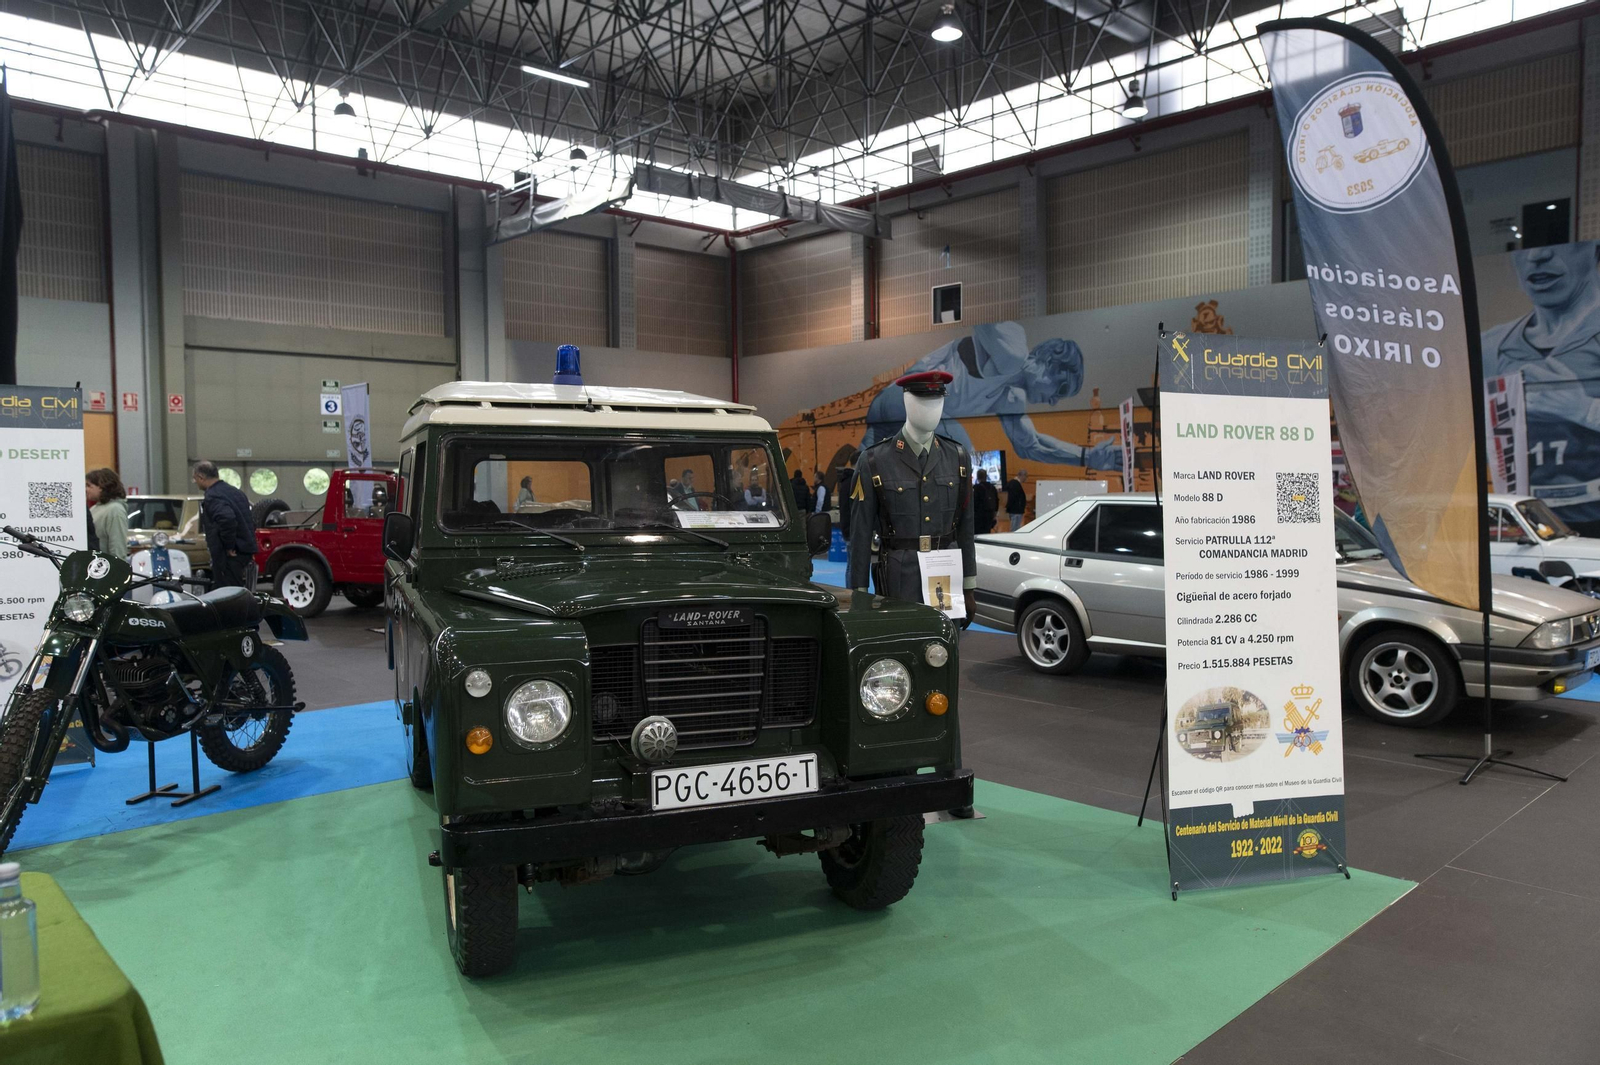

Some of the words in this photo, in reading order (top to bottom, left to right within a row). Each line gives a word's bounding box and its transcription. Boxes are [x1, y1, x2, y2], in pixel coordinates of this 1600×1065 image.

[1204, 349, 1278, 368] Guardia
[1287, 353, 1322, 370] Civil
[0, 396, 31, 407] dia
[41, 396, 77, 409] Civil
[328, 401, 336, 411] 3
[1176, 423, 1219, 439] LAND
[1223, 424, 1275, 440] ROVER
[1280, 426, 1299, 441] 88
[1304, 427, 1315, 441] D
[8, 448, 70, 460] DESERT
[1530, 440, 1568, 466] 17
[1173, 471, 1196, 479] Marca
[1197, 470, 1222, 480] LAND
[1225, 471, 1255, 480] ROVER
[1202, 492, 1214, 501] 88
[1216, 493, 1223, 501] D
[1175, 516, 1189, 524] Año
[1190, 516, 1230, 524] fabricación
[1231, 515, 1256, 524] 1986
[1175, 537, 1203, 545] Servicio
[1205, 536, 1252, 545] PATRULLA
[1254, 535, 1276, 544] 112ª
[0, 551, 24, 559] 980
[1199, 549, 1268, 558] COMANDANCIA
[1270, 548, 1308, 558] MADRID
[1176, 571, 1203, 580] Período
[1204, 571, 1214, 579] de
[1215, 571, 1243, 579] servicio
[1244, 569, 1269, 578] 1986
[1275, 569, 1300, 578] 1999
[27, 597, 45, 606] rpm
[1176, 591, 1217, 603] Cigüeñal
[1219, 592, 1230, 600] de
[1232, 592, 1258, 600] acero
[1260, 590, 1292, 601] forjado
[673, 610, 741, 622] LAND-ROVER
[1177, 617, 1214, 625] Cilindrada
[1215, 614, 1242, 624] 2.286
[1244, 613, 1257, 623] CC
[128, 617, 166, 628] OSSA
[1177, 638, 1209, 646] Potencia
[1210, 636, 1223, 645] 81
[1225, 635, 1238, 644] CV
[1247, 634, 1274, 643] 4.250
[1276, 635, 1294, 644] rpm
[1178, 662, 1201, 670] Precio
[1202, 658, 1250, 669] 1.515.884
[1253, 656, 1293, 666] PESETAS
[655, 758, 814, 805] PGC-4656-T
[1171, 789, 1193, 797] Escanear
[1215, 785, 1223, 793] QR
[1175, 823, 1207, 836] Centenario
[1207, 821, 1217, 833] del
[1217, 819, 1240, 832] Servicio
[1241, 818, 1248, 830] de
[1249, 816, 1272, 829] Material
[1273, 814, 1288, 827] Móvil
[1288, 814, 1296, 825] de
[1296, 813, 1302, 824] la
[1303, 811, 1325, 824] Guardia
[1325, 810, 1339, 822] Civil
[1231, 838, 1253, 858] 1922
[1260, 836, 1283, 855] 2022
